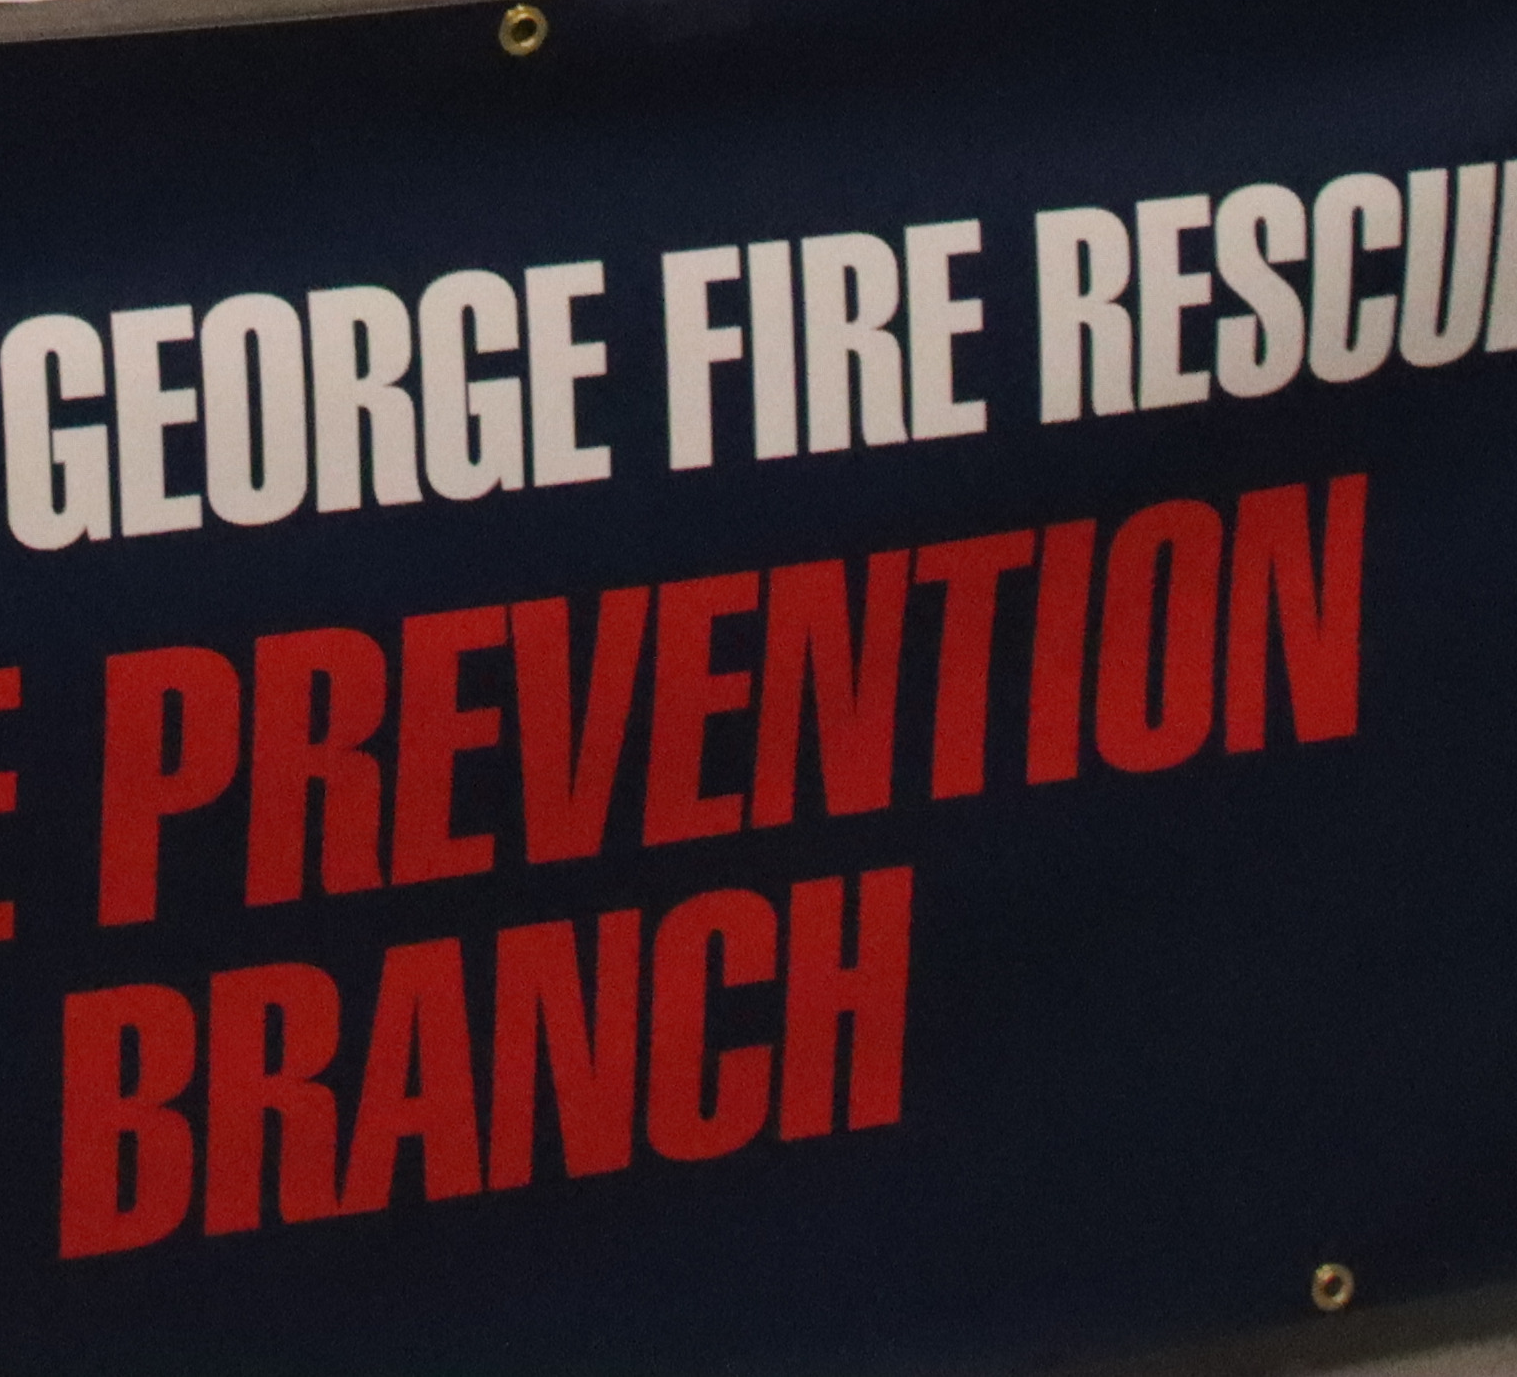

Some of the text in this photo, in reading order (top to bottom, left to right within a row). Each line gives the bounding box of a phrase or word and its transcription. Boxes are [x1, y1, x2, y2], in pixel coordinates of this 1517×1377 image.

[0, 260, 611, 552] GEORGE
[660, 219, 984, 471] FIRE
[96, 473, 1371, 928] PREVENTION
[59, 864, 914, 1260] BRANCH
